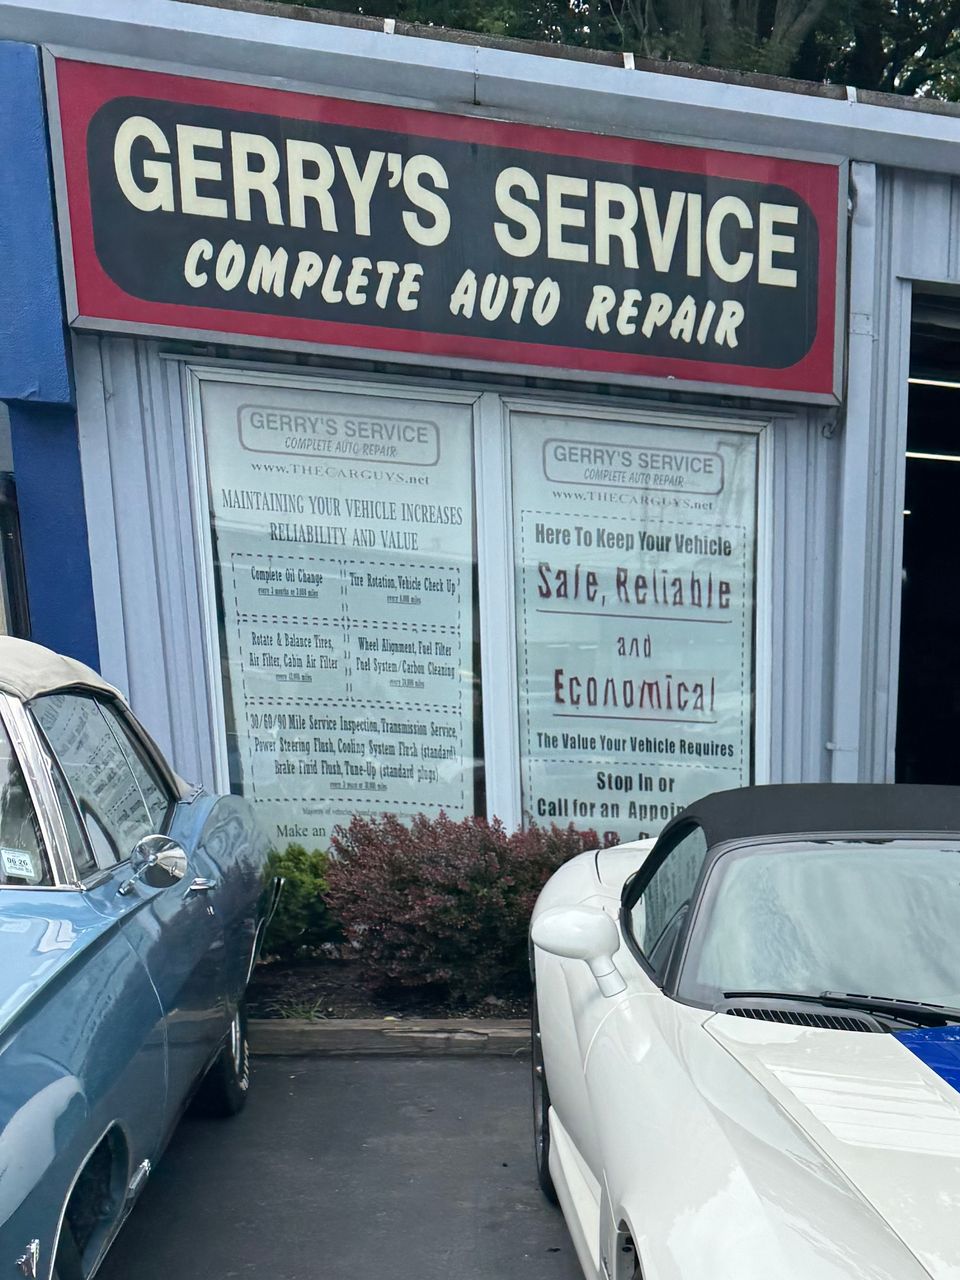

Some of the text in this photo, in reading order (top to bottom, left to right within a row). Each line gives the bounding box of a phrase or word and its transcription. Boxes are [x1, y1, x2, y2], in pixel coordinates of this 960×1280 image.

[114, 116, 799, 288] GERRY'S SERVICE
[184, 238, 745, 348] COMPLETE AUTO REPAIR
[250, 411, 428, 443] GERRY'S SERVICE
[285, 437, 332, 452] COMPLETE
[363, 443, 397, 457] REPAIR
[553, 445, 713, 474] GERRY'S SERVICE
[584, 468, 684, 487] COMPLETE AUTO REPAIR
[222, 489, 463, 525] MAINTAINING YOUR VEHICLE INCREASES
[270, 522, 418, 550] RELIABILITY AND VALUE
[536, 523, 732, 556] Here To Keep Your Vehicle
[251, 566, 323, 585] Complete Oil Change
[398, 575, 421, 591] Vehicle
[424, 577, 443, 592] Check
[447, 577, 456, 596] Up
[538, 562, 731, 609] Safe, Reliable
[252, 632, 334, 650] Rotate & Balance Tires,
[358, 637, 378, 651] Wheel
[419, 641, 432, 655] Fuel
[435, 642, 452, 656] Filter
[617, 634, 651, 658] and
[250, 653, 338, 669] Air Filter, Cabin Air Filter
[356, 657, 370, 671] Fuel
[428, 662, 455, 679] Cleaning
[554, 668, 715, 712] Economical
[289, 714, 306, 731] Mile
[309, 715, 336, 731] Service
[381, 719, 427, 736] Transmission
[431, 722, 458, 739] Service,
[255, 737, 276, 752] Power
[280, 737, 310, 756] Steering
[314, 739, 336, 755] Flush,
[338, 739, 365, 757] Cooling
[369, 740, 395, 757] System
[537, 732, 734, 757] The Value Your Vehicle Requires
[275, 760, 295, 775] Brake
[321, 760, 343, 778] Flush,
[345, 761, 376, 779] Tune-Up
[380, 763, 414, 779] (standard
[597, 770, 675, 792] Stop In or
[538, 798, 568, 817] Call
[573, 799, 595, 817] for
[601, 802, 620, 818] an
[277, 824, 309, 838] Make
[313, 827, 326, 838] an
